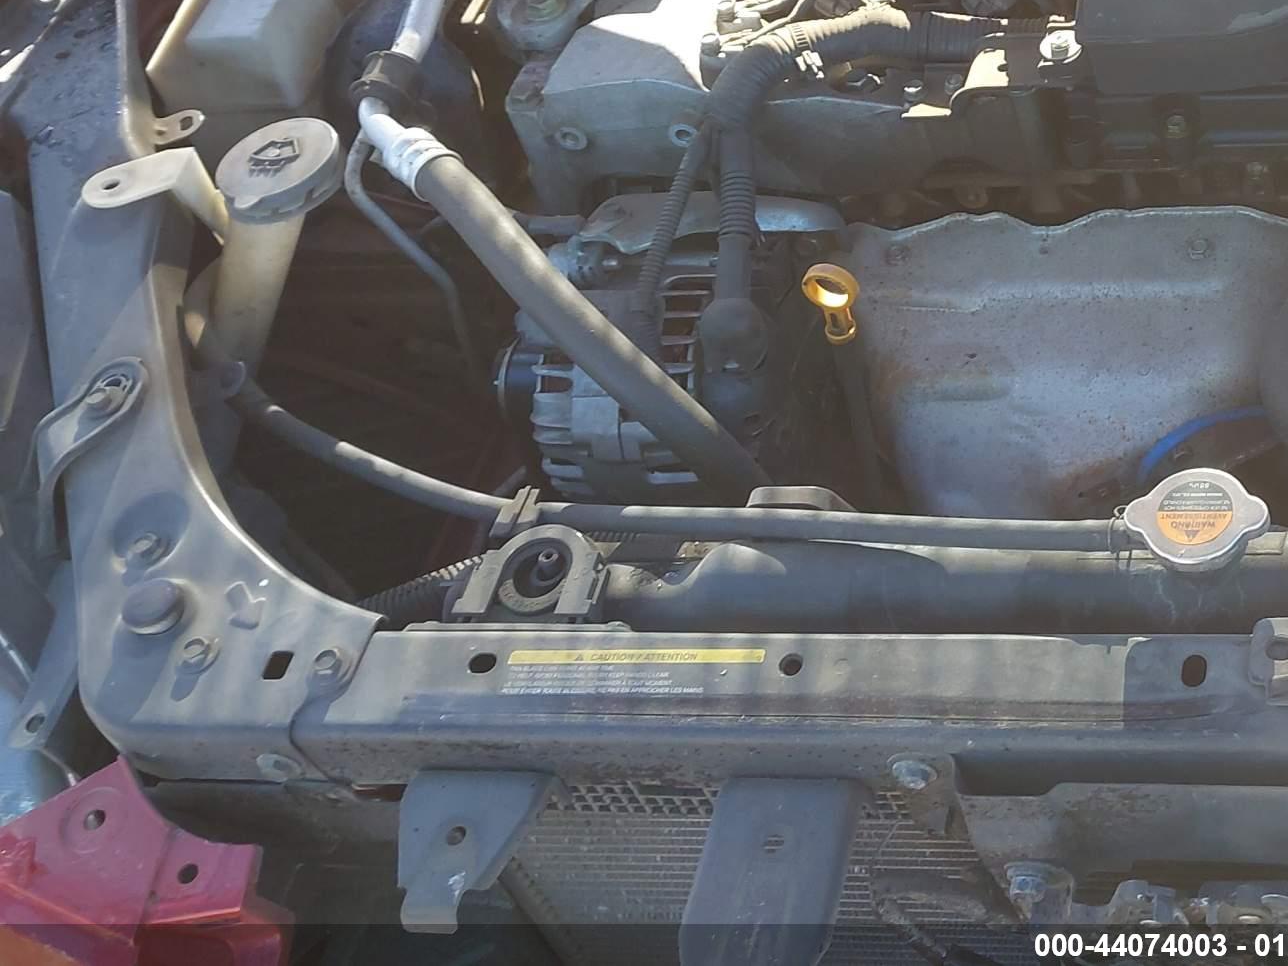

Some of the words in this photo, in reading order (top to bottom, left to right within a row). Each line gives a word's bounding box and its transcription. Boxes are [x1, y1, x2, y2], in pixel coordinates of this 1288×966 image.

[1170, 521, 1216, 529] WARNING
[590, 652, 635, 661] CAUTION
[644, 652, 698, 661] ATTENTION
